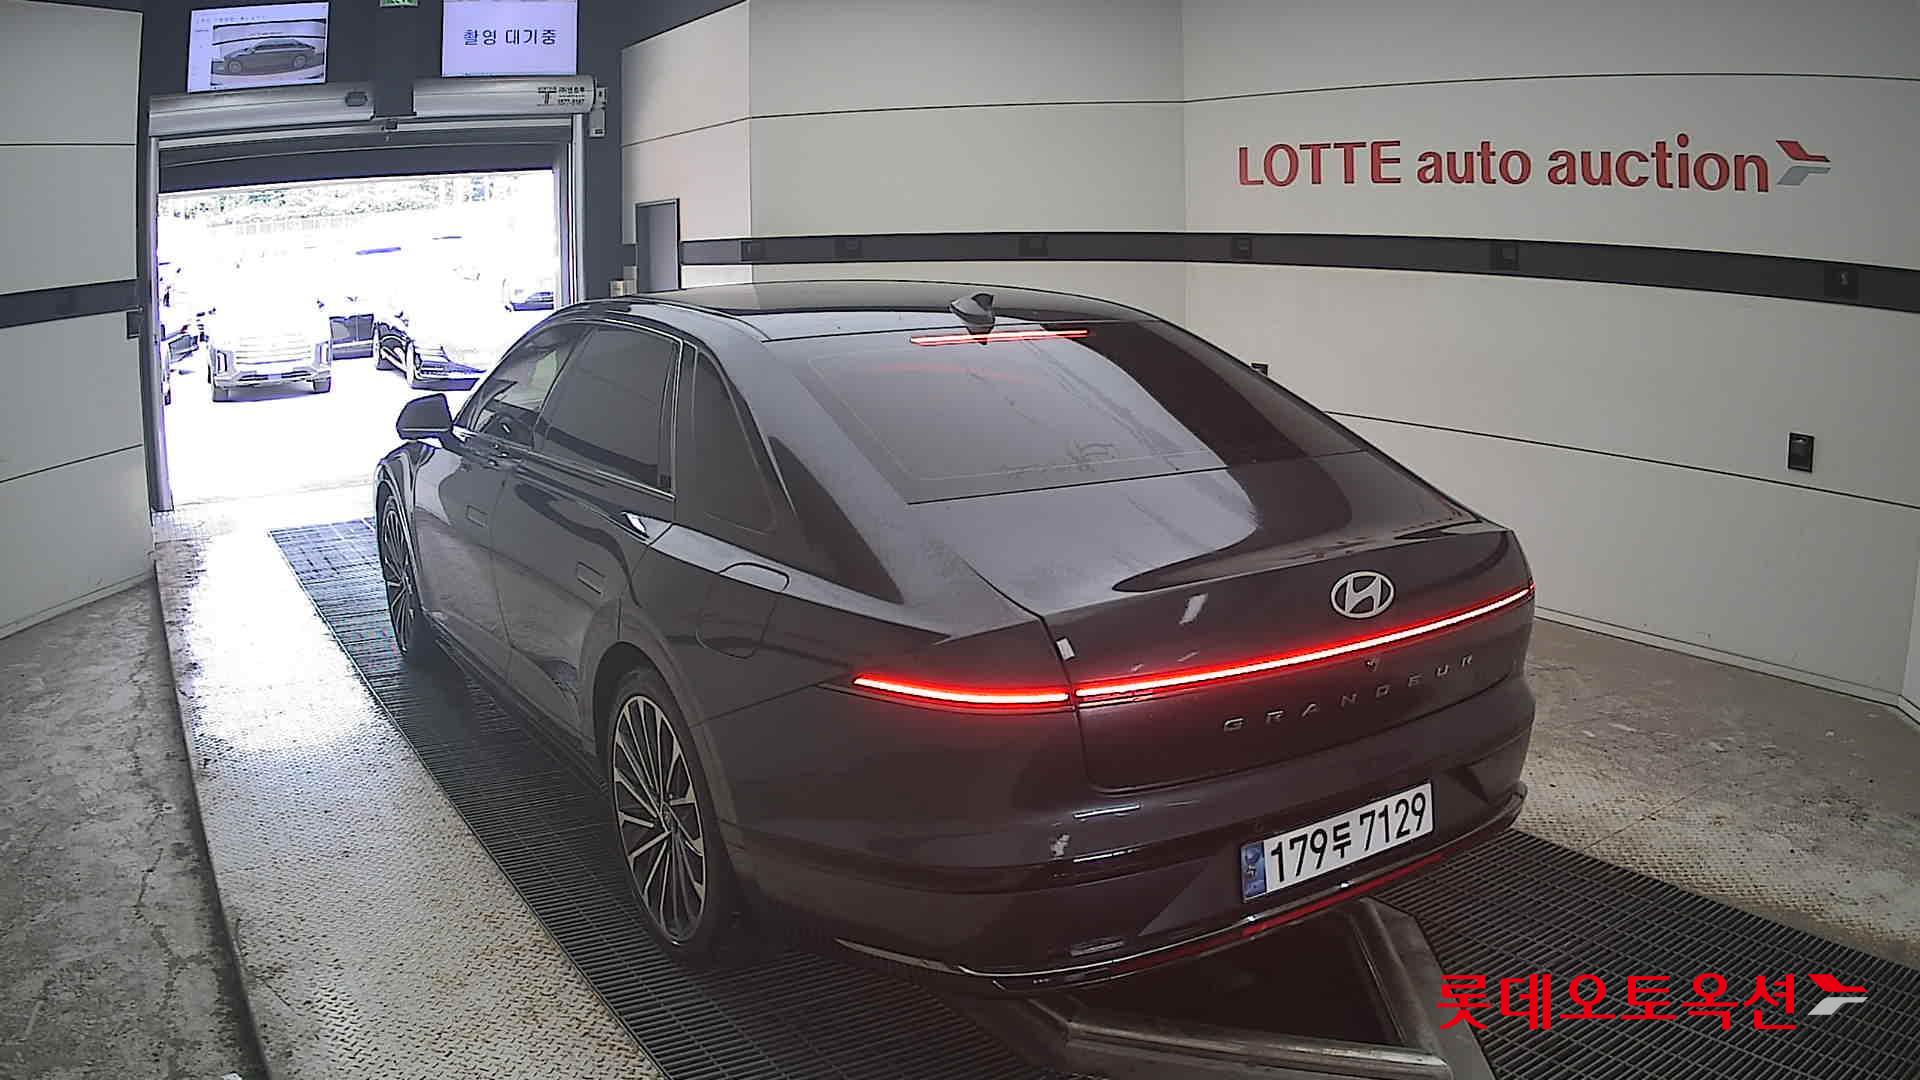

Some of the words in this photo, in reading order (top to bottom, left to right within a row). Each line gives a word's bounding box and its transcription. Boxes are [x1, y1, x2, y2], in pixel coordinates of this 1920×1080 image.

[463, 29, 497, 46] 촬영
[505, 29, 557, 46] 대기중
[1238, 141, 1401, 187] LOTTE
[1417, 141, 1532, 184] auto
[1549, 134, 1770, 192] auction
[1223, 654, 1473, 732] GRANDEUR
[1359, 792, 1426, 852] 7129
